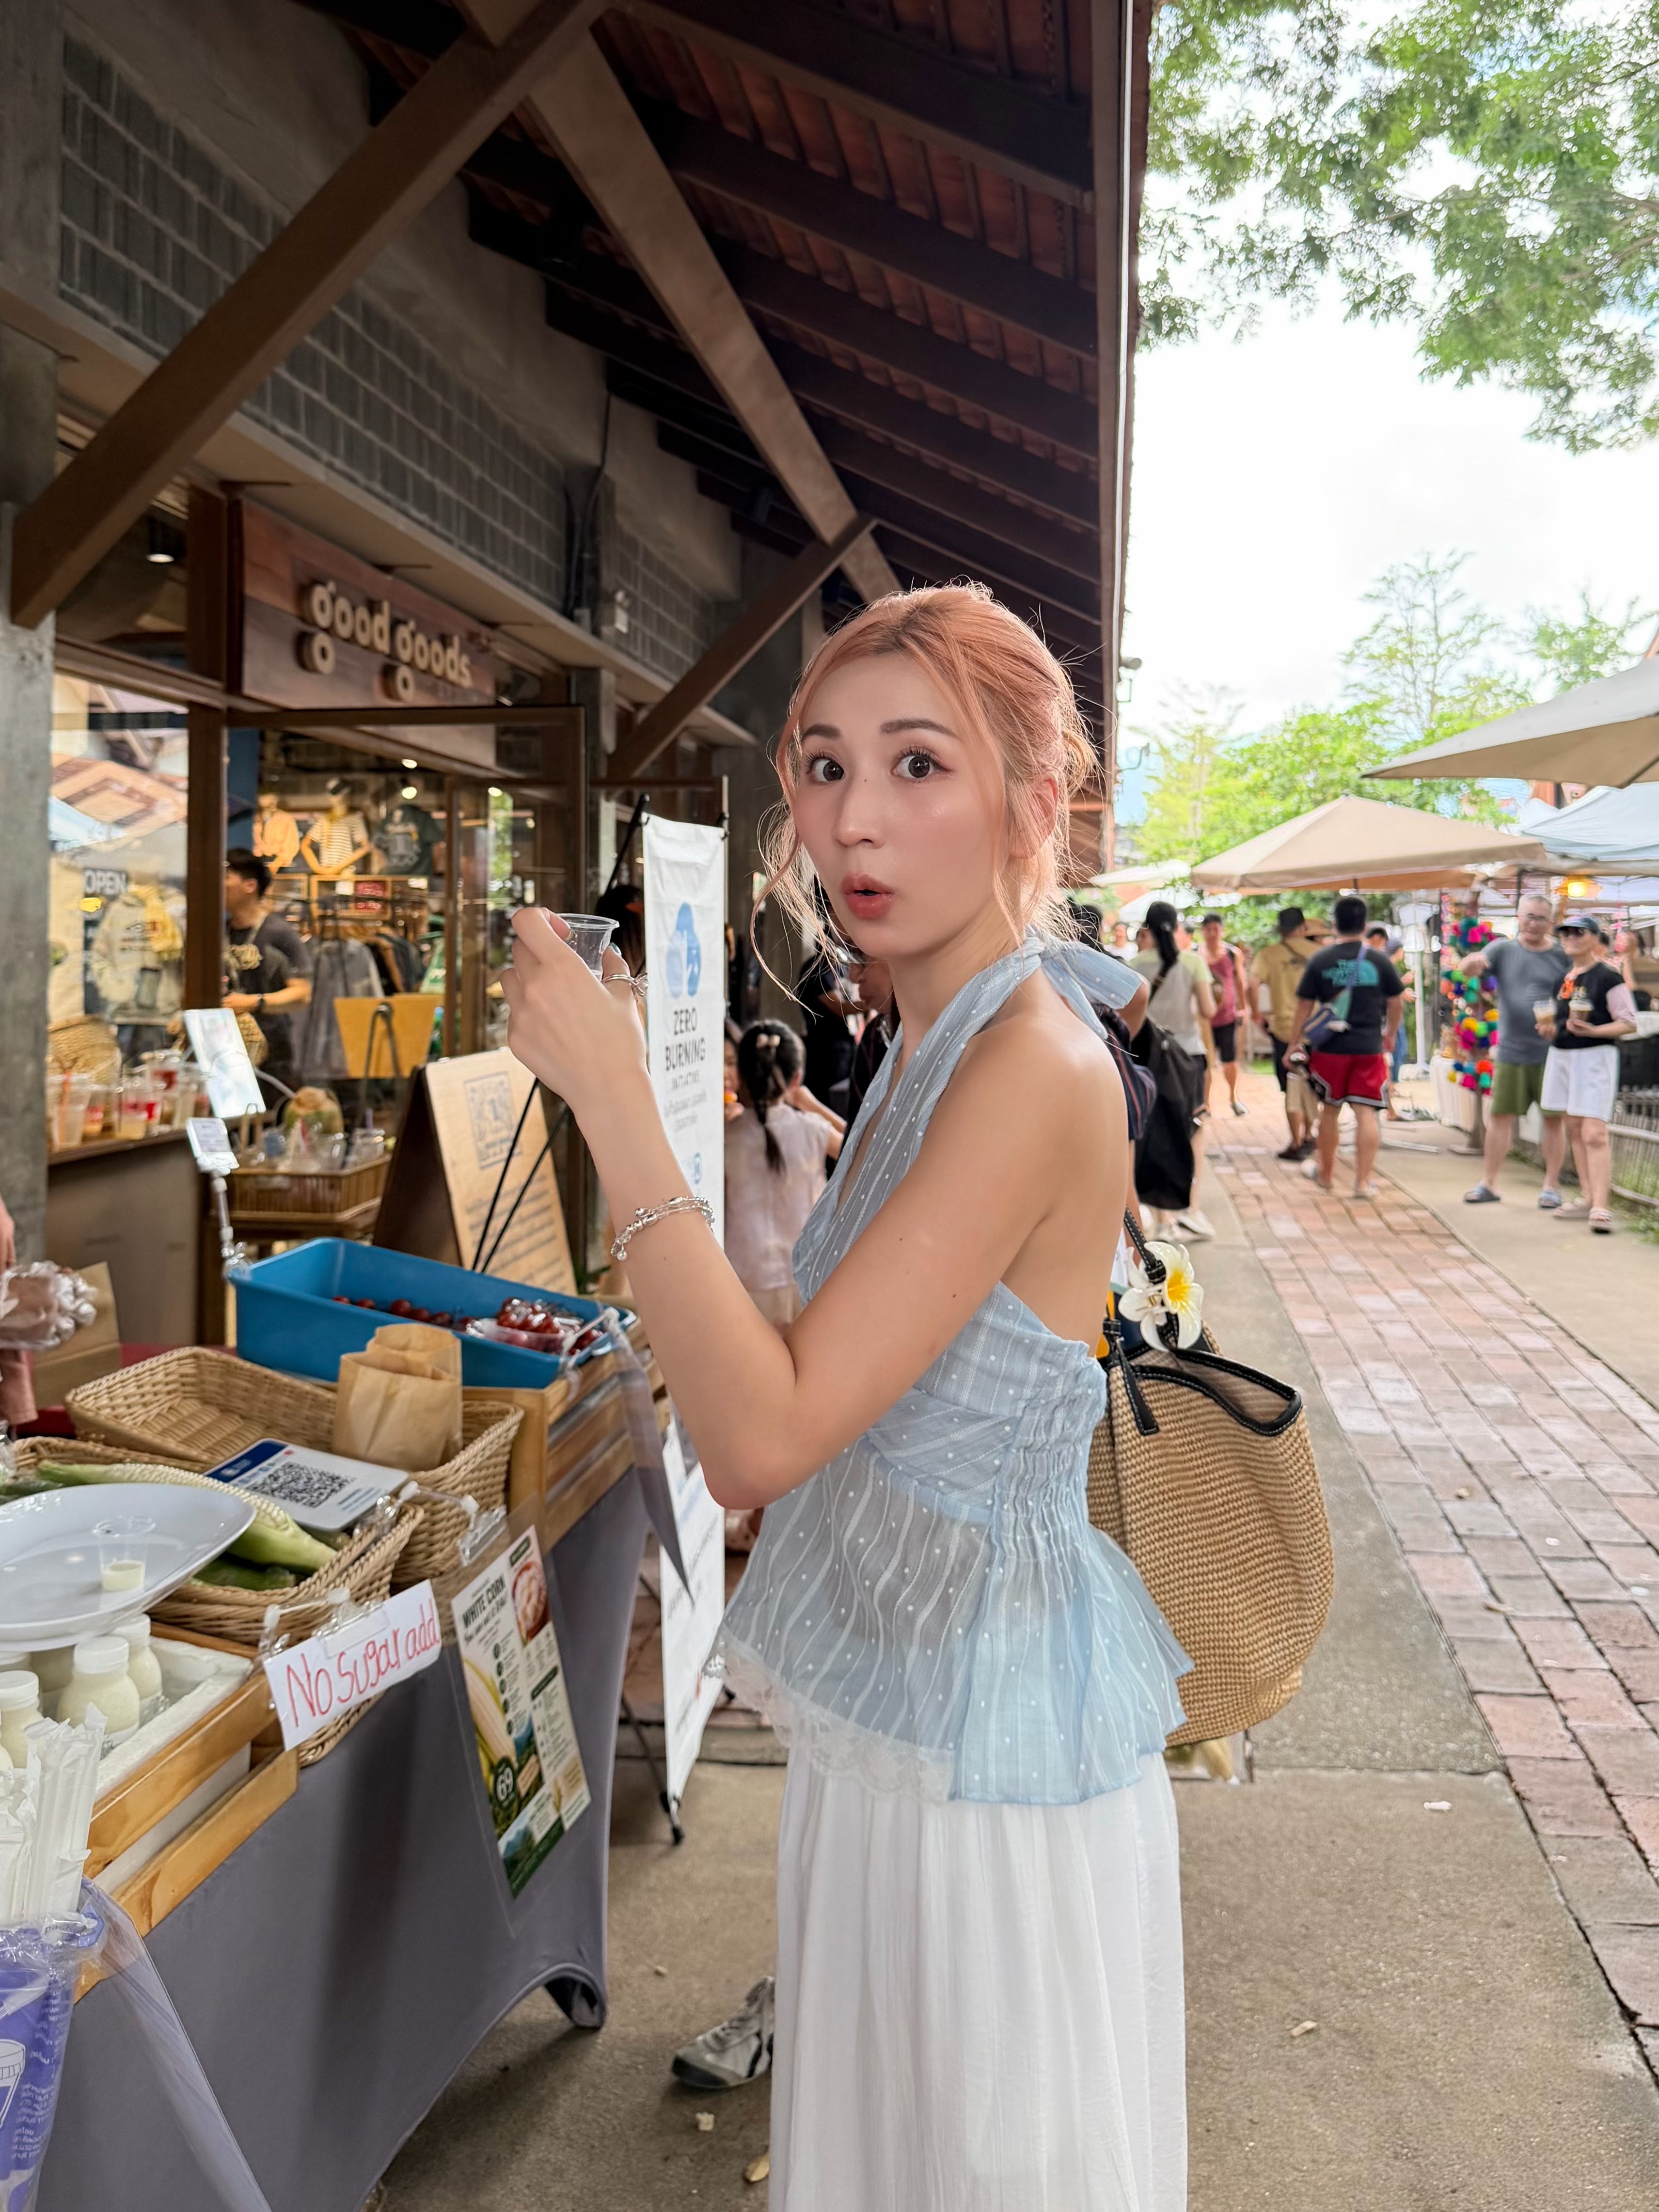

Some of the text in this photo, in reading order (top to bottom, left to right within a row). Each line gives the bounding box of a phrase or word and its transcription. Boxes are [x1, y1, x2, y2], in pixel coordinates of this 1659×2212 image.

[311, 581, 473, 703] good goods
[83, 869, 126, 895] OPEN
[674, 1007, 697, 1035] ZERO
[665, 1037, 706, 1071] BURNING
[463, 1593, 486, 1629] WHITE
[286, 1653, 333, 1728] No
[405, 1598, 440, 1661] add
[496, 1767, 514, 1801] 69
